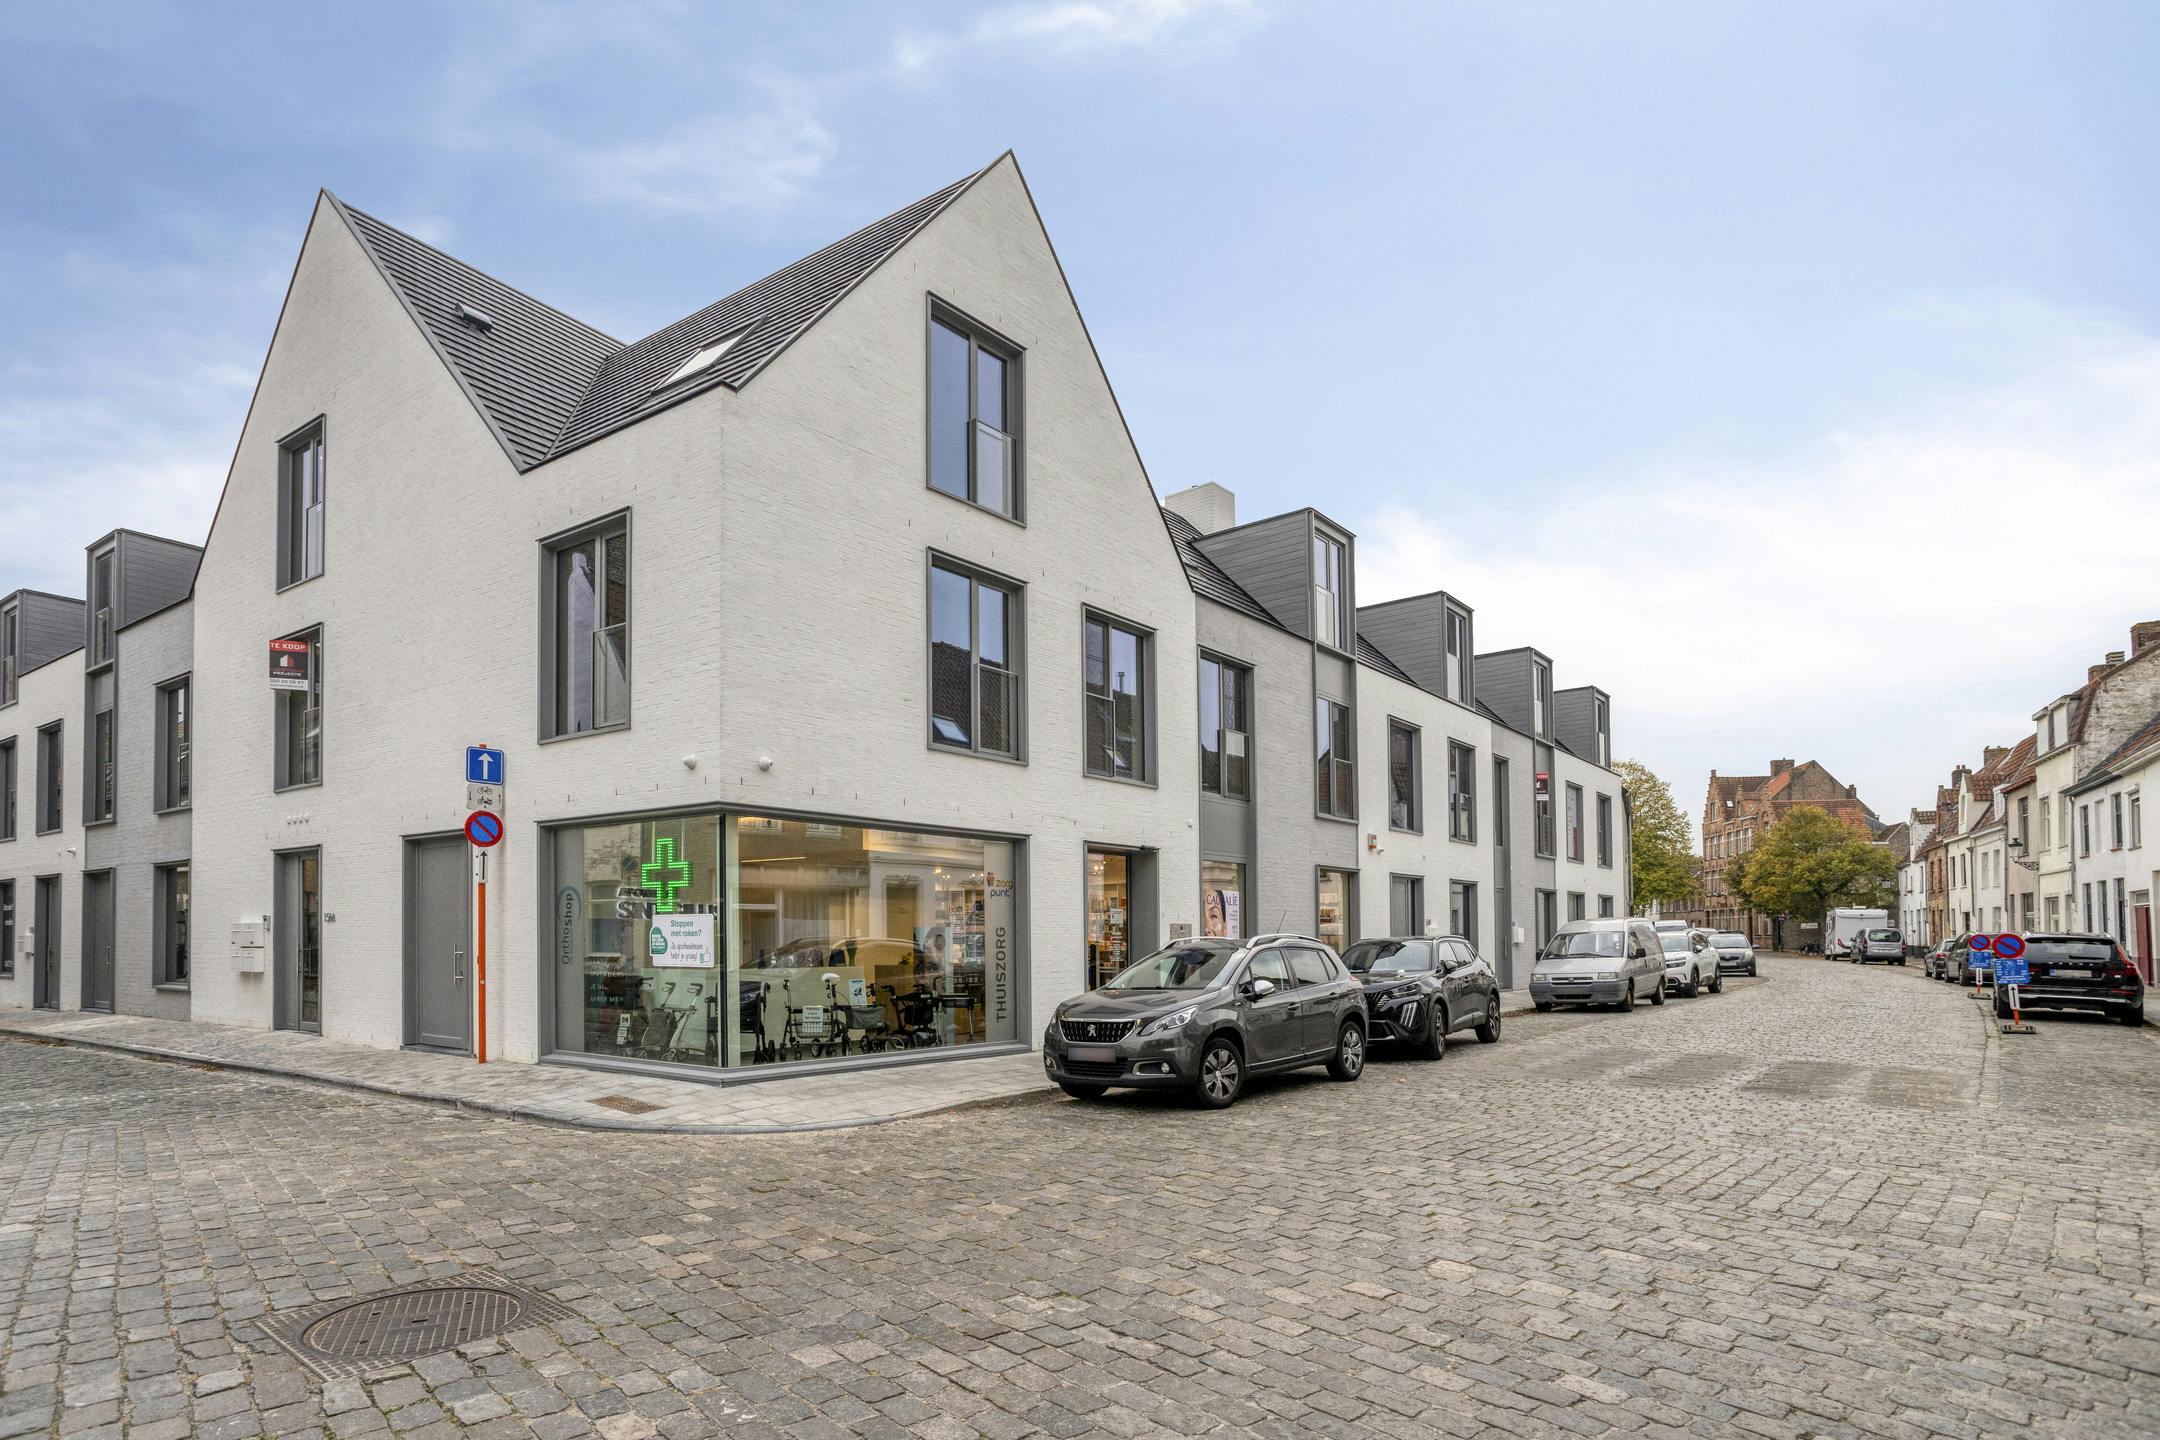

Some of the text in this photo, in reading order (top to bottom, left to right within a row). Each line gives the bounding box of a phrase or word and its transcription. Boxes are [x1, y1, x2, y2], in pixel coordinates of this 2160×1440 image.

[995, 879, 1013, 889] zorg
[990, 888, 1011, 898] punt
[670, 919, 694, 928] Stoppen
[683, 929, 702, 937] roken?
[996, 926, 1006, 1023] THUISZORG
